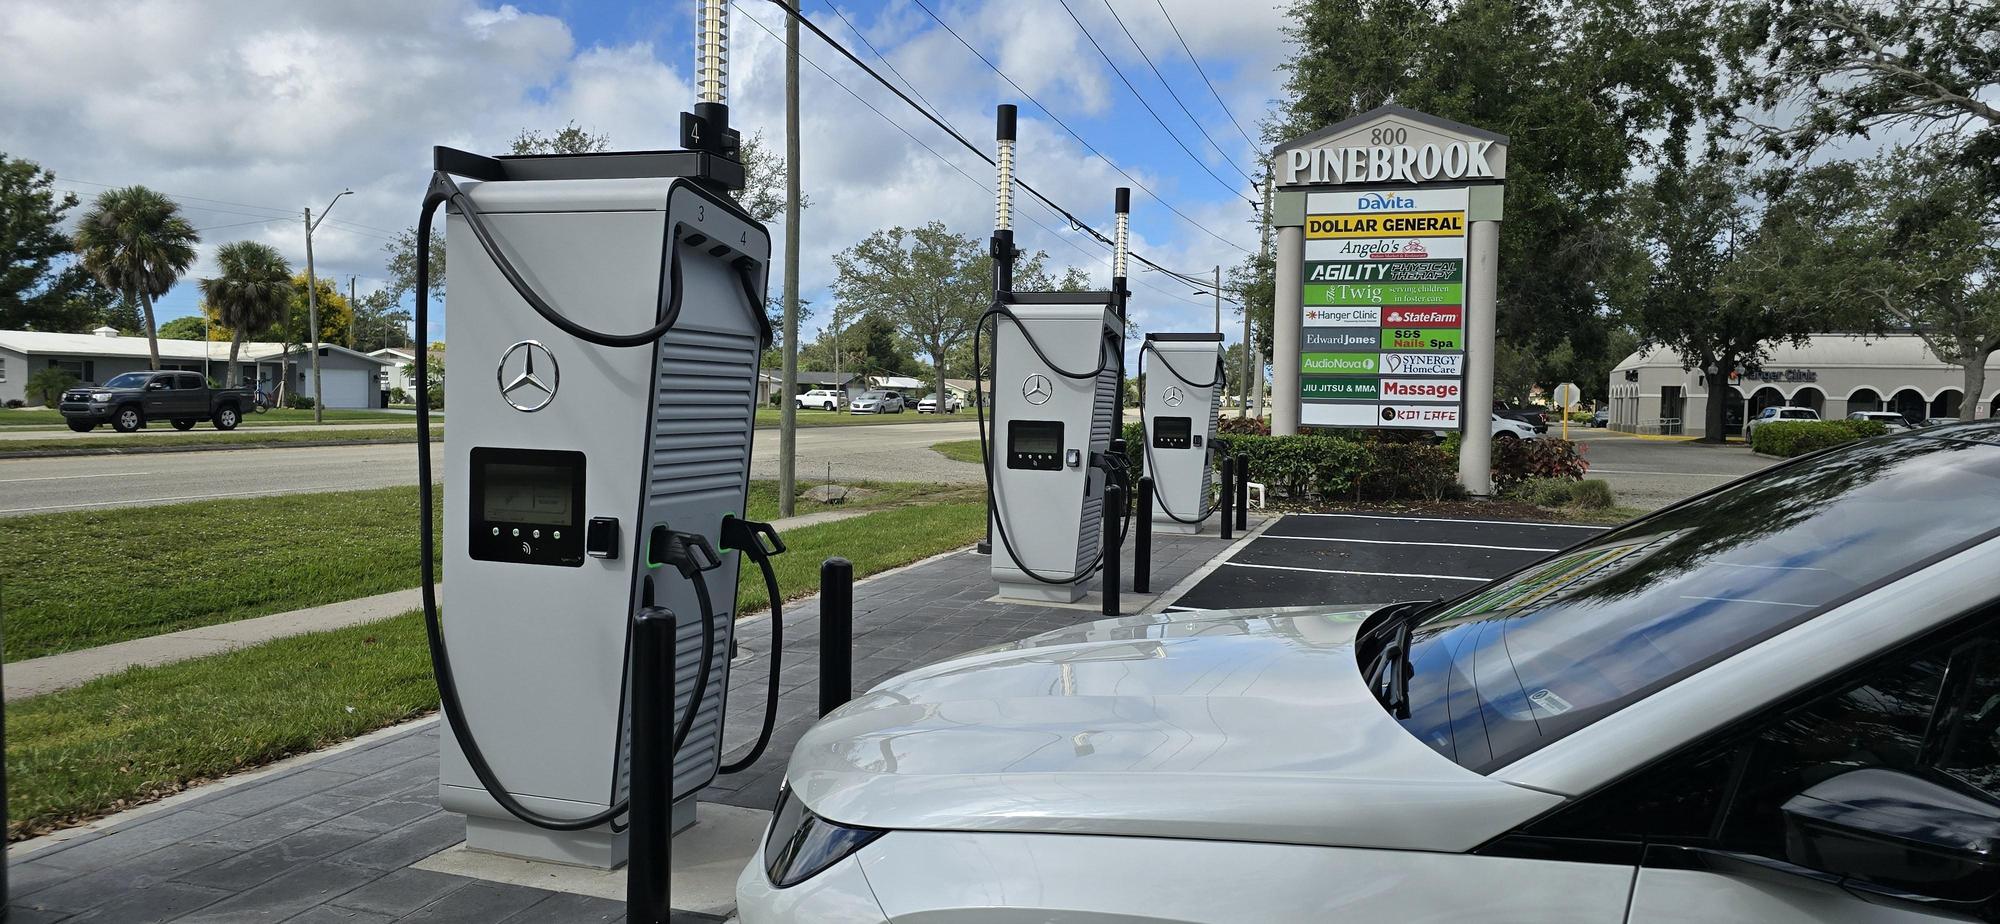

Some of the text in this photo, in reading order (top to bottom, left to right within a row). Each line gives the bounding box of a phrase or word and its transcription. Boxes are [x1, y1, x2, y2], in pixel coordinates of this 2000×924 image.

[690, 122, 700, 144] 4
[1371, 127, 1407, 146] 800
[1285, 139, 1496, 184] PINEBROOK
[1357, 193, 1415, 210] DaVita
[697, 205, 705, 223] 3
[1309, 217, 1462, 234] DOLLAR GENERAL
[740, 231, 746, 247] 4
[1339, 239, 1400, 258] Angelo's
[1310, 263, 1391, 282] AGILITY
[1391, 261, 1457, 272] PHYSICAL
[1337, 284, 1382, 303] Twig
[1389, 286, 1417, 294] serving
[1403, 294, 1425, 302] foster
[1317, 309, 1377, 322] Hanger Clinic
[1394, 330, 1421, 339] S&S
[1393, 339, 1453, 350] Nails Spa
[1303, 357, 1362, 369] AudioNova
[1403, 355, 1457, 365] SYNERGY
[1403, 364, 1456, 374] HomeCare
[1785, 369, 1817, 381] Clinic
[1303, 384, 1377, 393] JIU JITSU & MMA
[1384, 381, 1458, 398] Massage
[1424, 411, 1457, 421] CAFE
